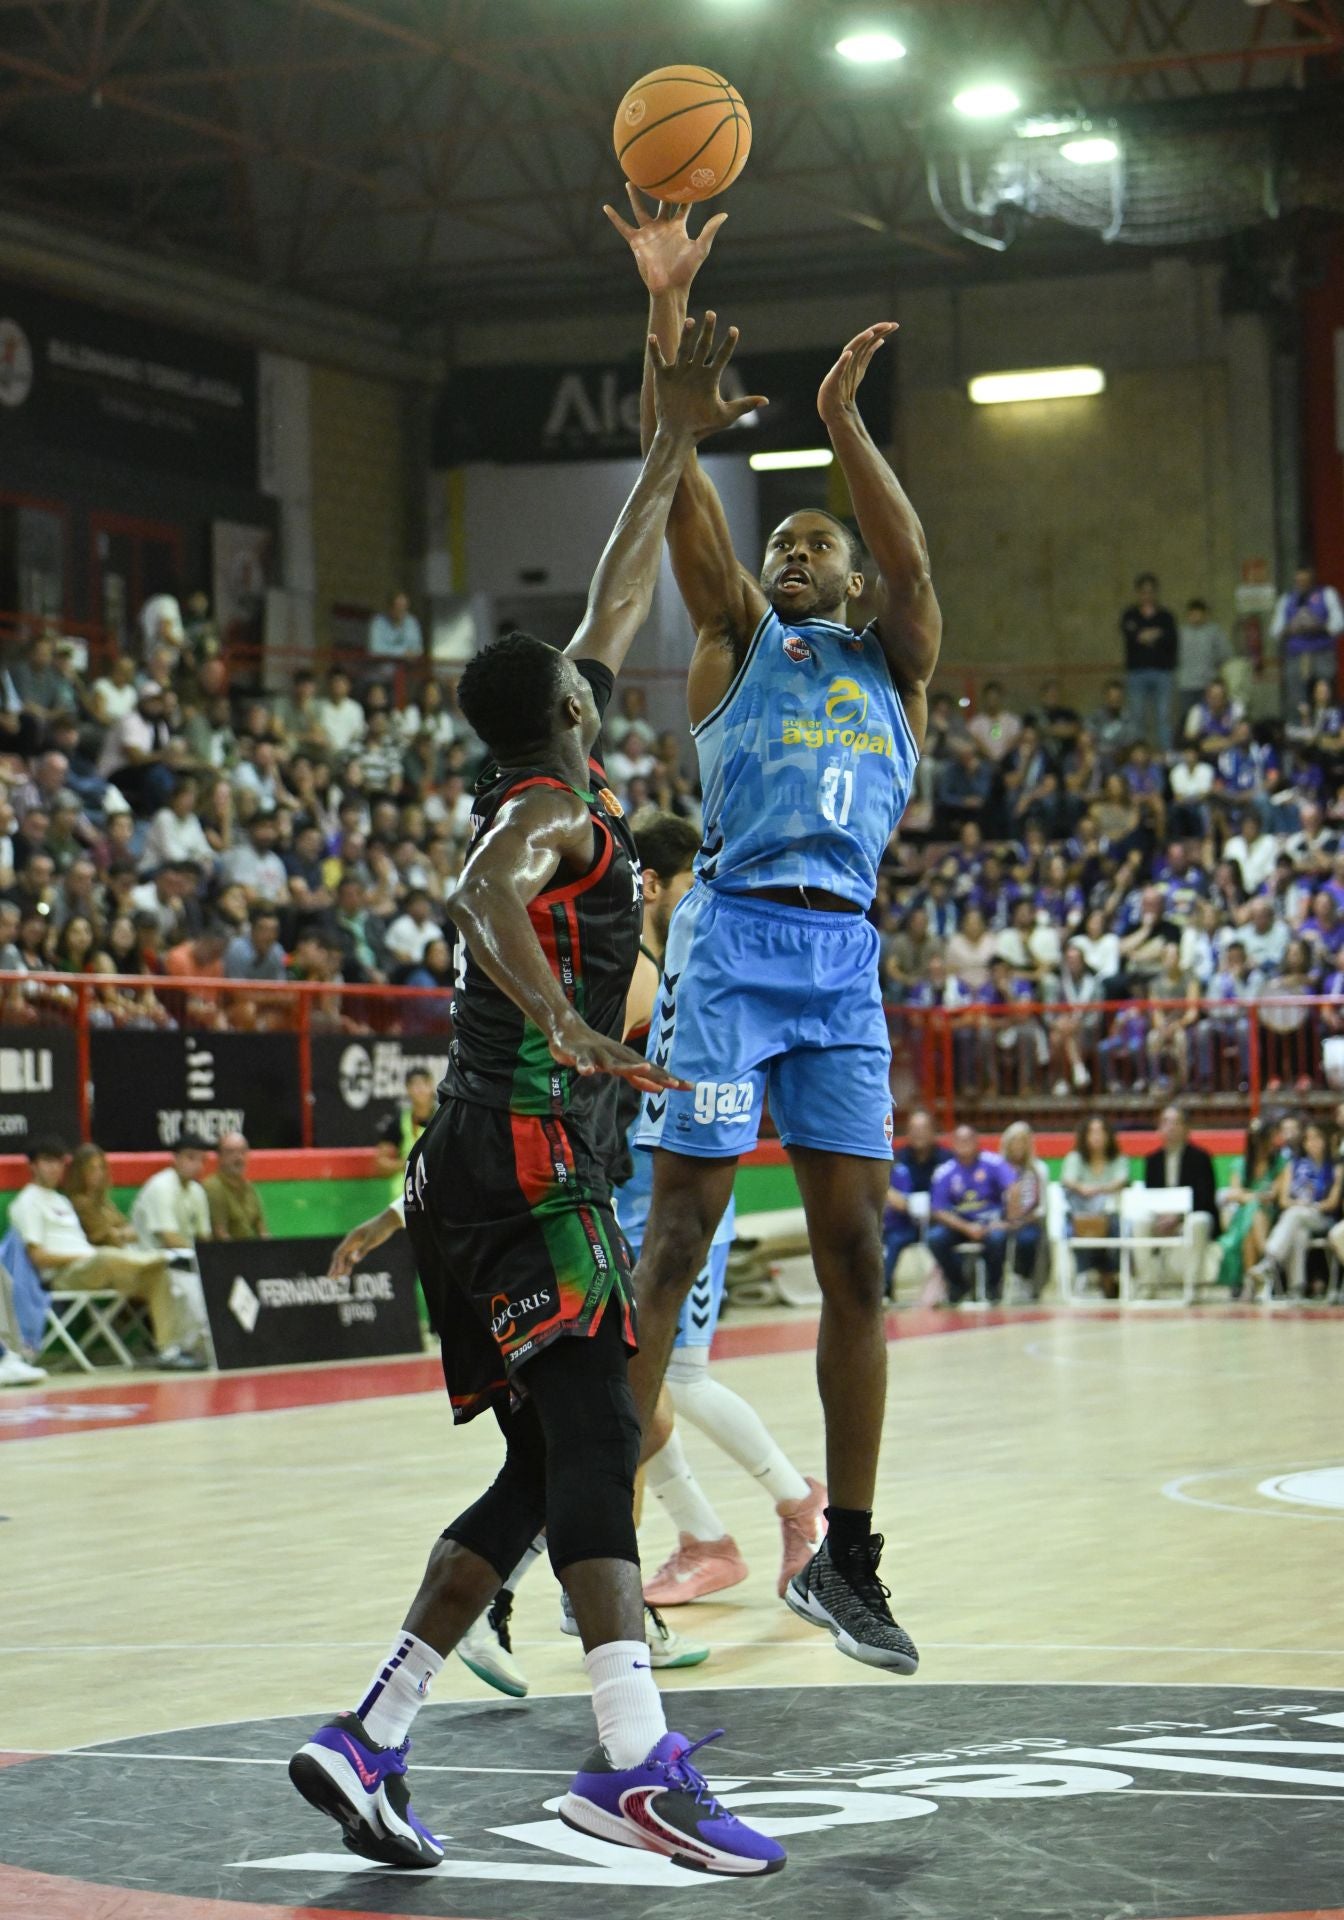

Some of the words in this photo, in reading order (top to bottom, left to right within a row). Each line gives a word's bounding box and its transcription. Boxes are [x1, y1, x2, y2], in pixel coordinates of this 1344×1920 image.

[782, 728, 892, 757] agropal
[592, 1244, 608, 1269] 39300
[509, 1340, 533, 1362] 39300
[772, 1737, 1067, 1779] derecho
